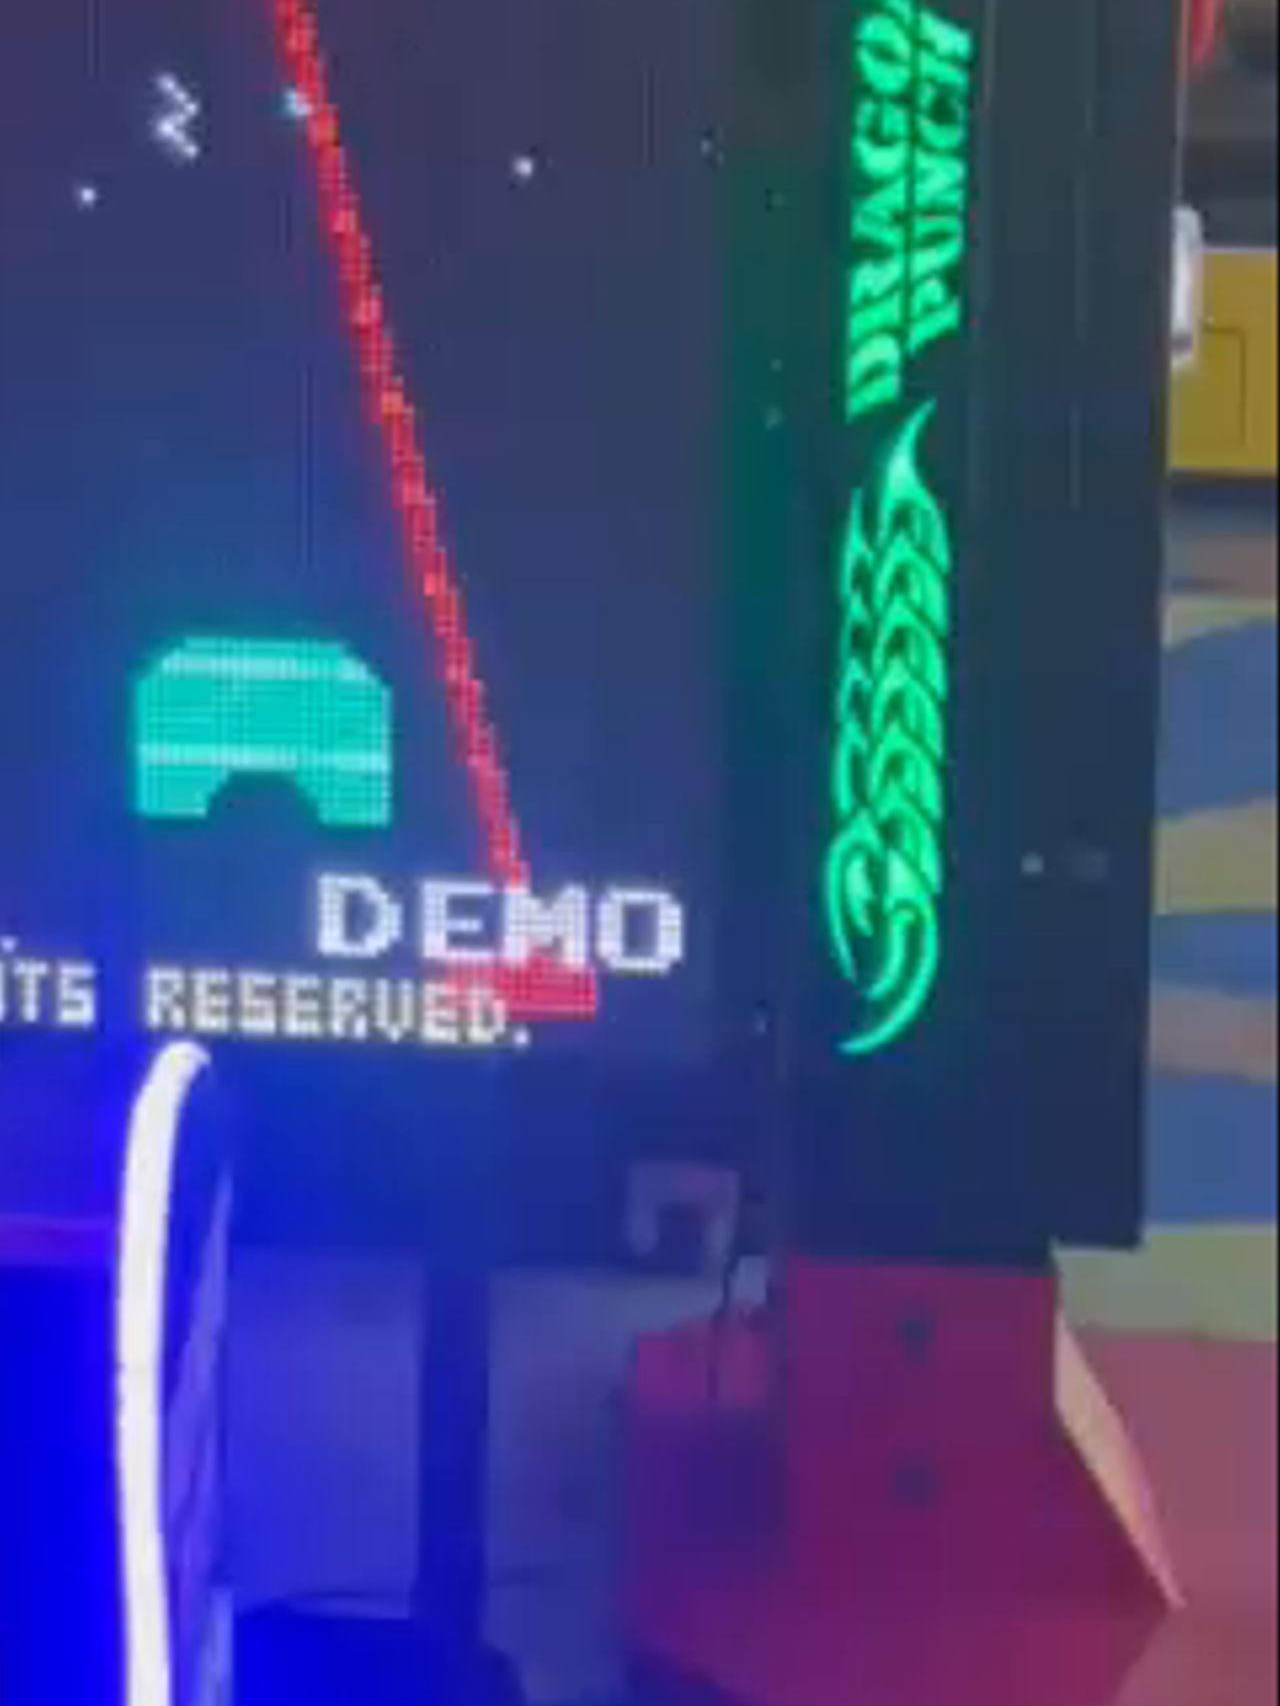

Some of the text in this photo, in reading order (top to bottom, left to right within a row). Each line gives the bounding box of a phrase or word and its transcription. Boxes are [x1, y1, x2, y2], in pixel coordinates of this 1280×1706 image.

[906, 8, 974, 359] PUNCH
[316, 872, 685, 976] DEMO
[143, 965, 533, 1047] RESERVED.
